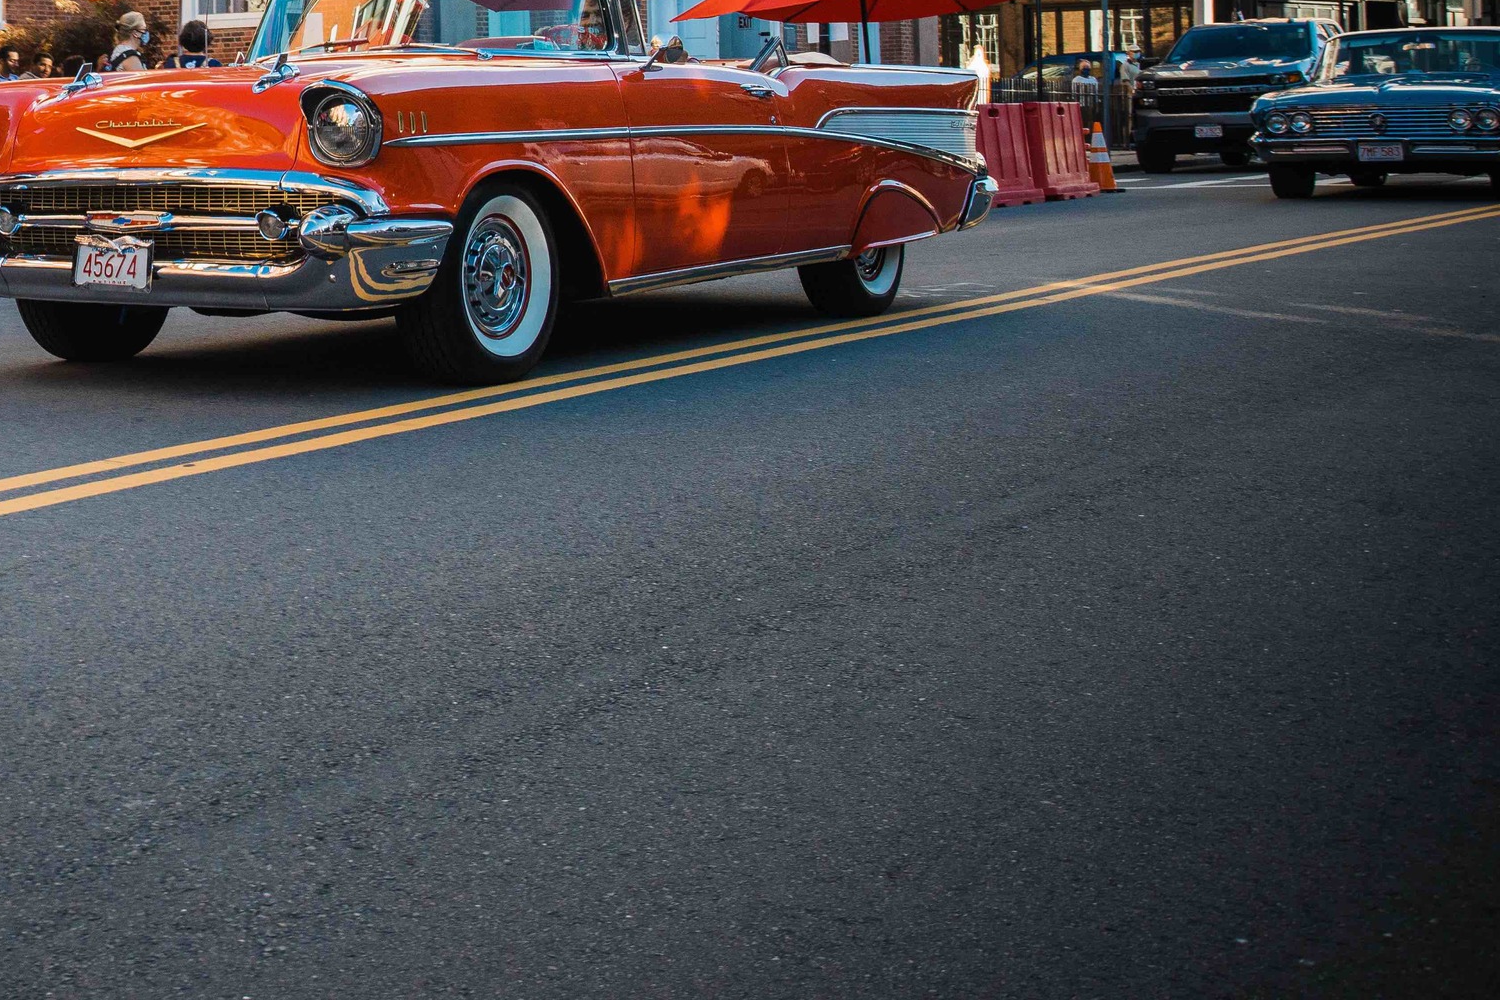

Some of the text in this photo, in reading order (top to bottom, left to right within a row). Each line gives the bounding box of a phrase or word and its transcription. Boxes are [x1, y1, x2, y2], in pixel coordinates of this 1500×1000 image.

[738, 16, 752, 29] EXIT
[95, 118, 182, 129] Chevrolet
[82, 253, 138, 279] 45674
